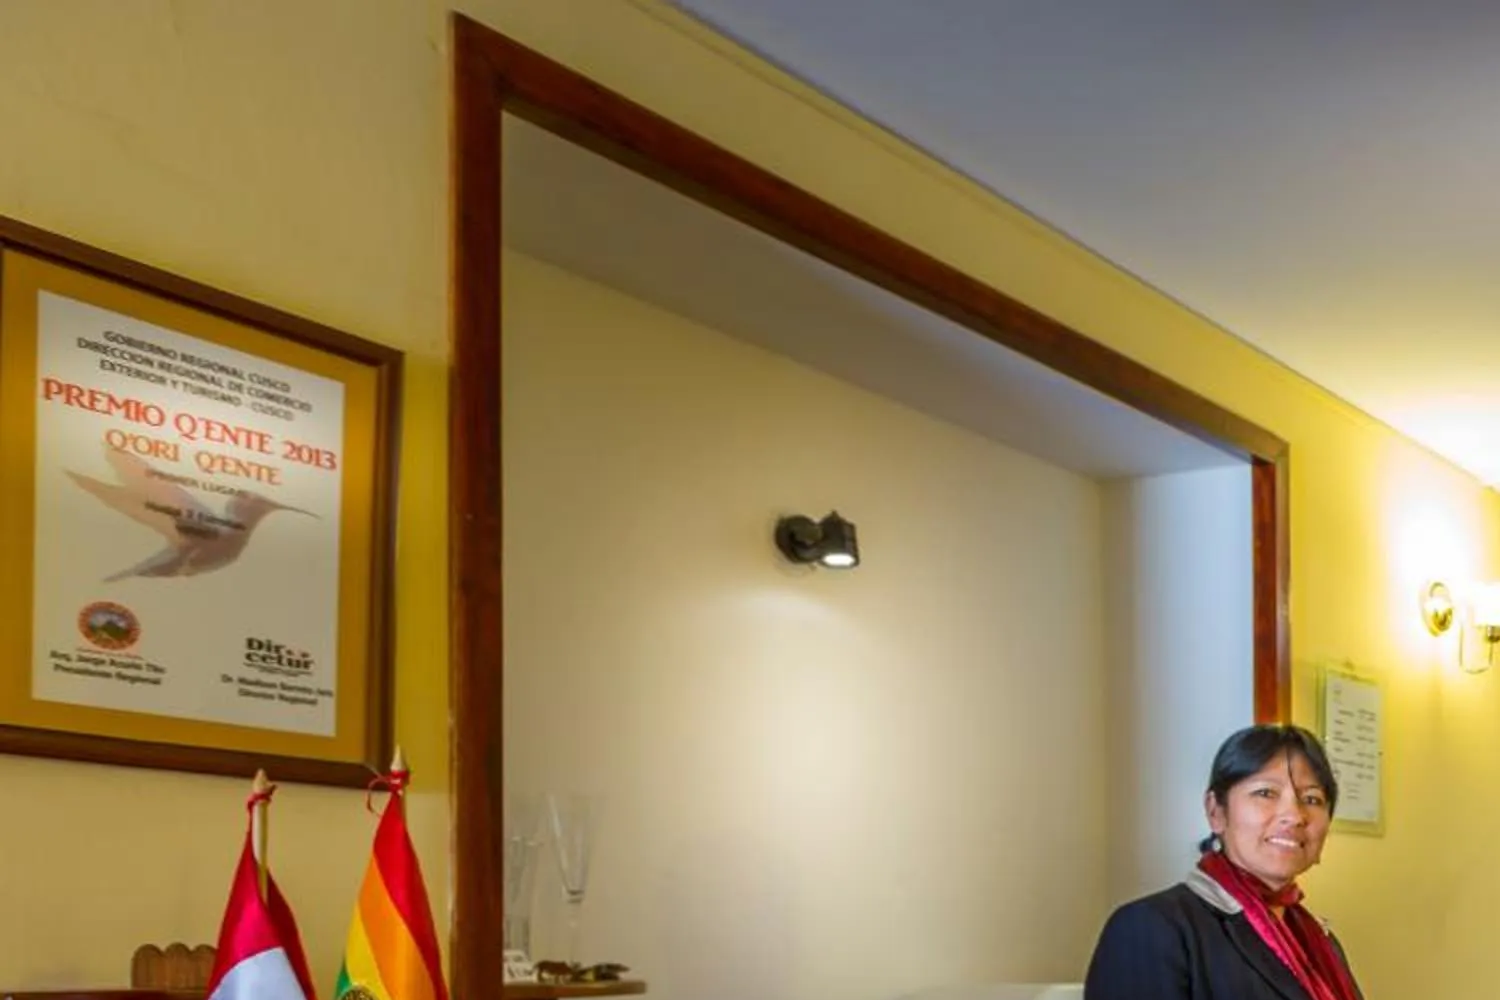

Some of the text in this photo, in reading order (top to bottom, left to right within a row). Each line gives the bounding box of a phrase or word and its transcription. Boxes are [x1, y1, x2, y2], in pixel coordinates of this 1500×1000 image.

[77, 337, 312, 413] DIRECCION REGIONAL DE COMERCIO
[100, 359, 295, 422] EXTERIOR Y TURISMO CUSCO
[103, 330, 291, 394] GOBIERNO REGIONAL CUSCO
[42, 378, 338, 471] PREMIO Q'ENTE 2013
[105, 429, 283, 486] Q'ORI Q'ENTE
[245, 651, 316, 670] cetur
